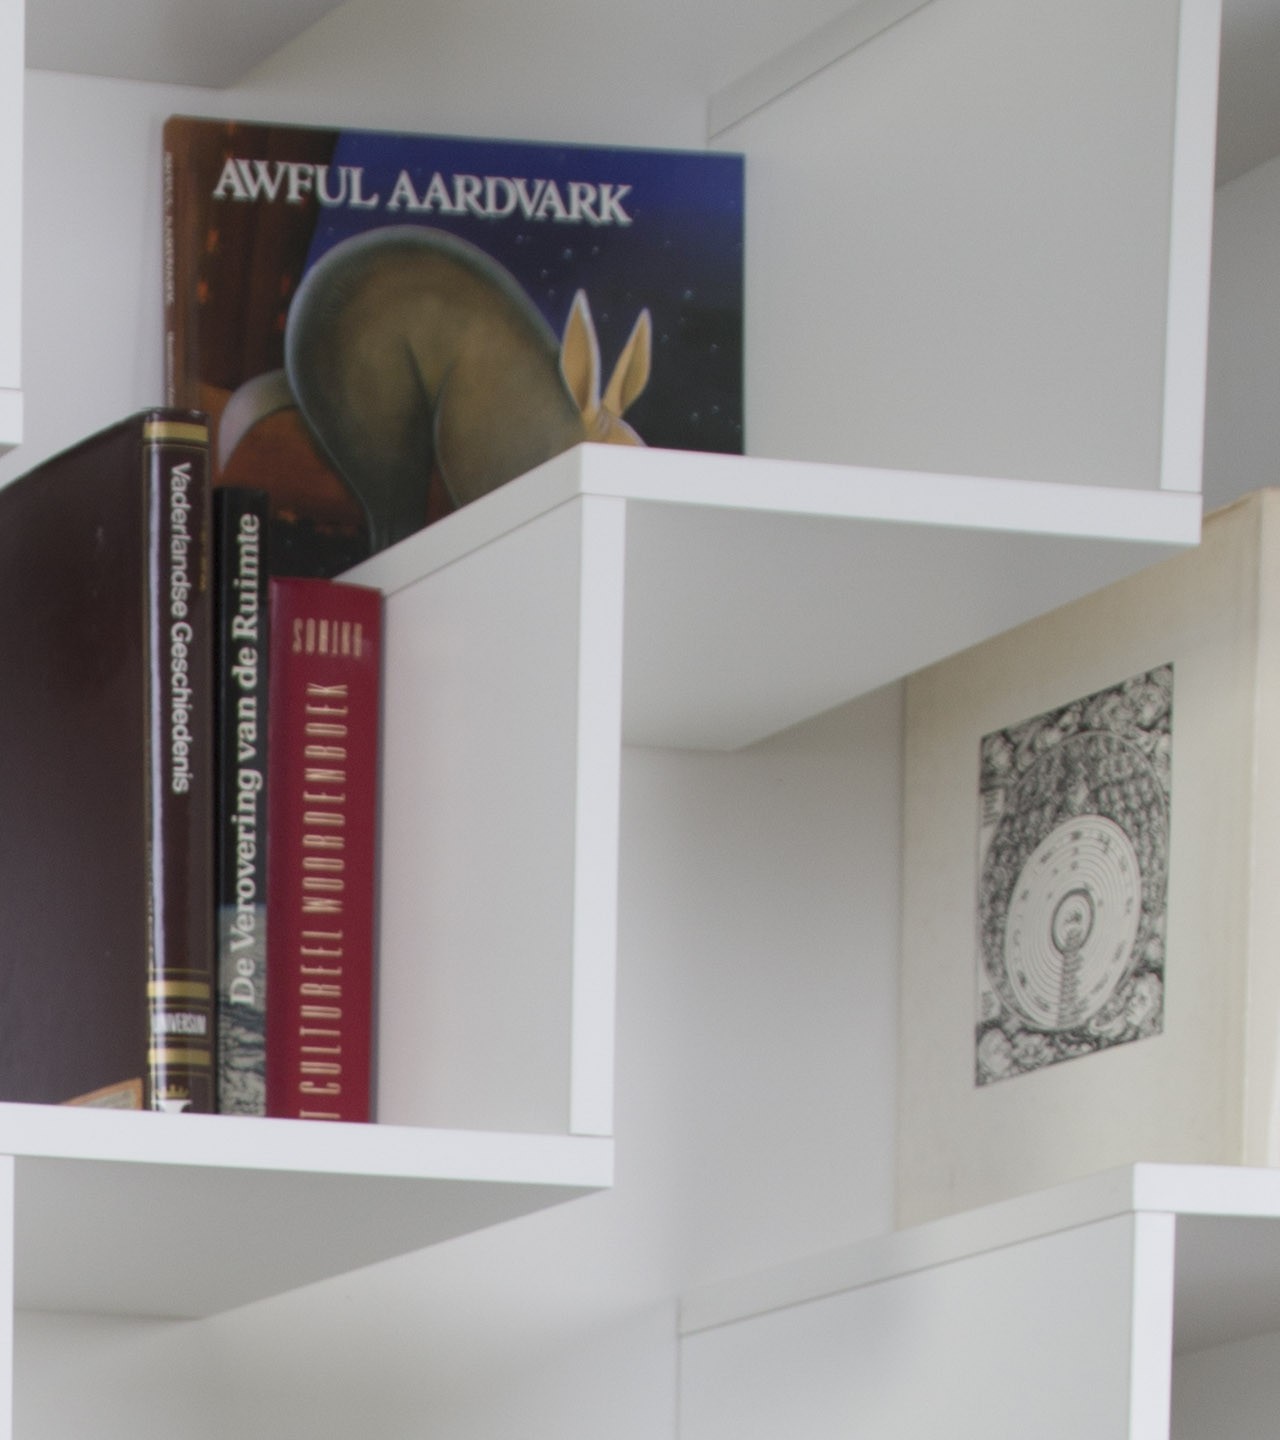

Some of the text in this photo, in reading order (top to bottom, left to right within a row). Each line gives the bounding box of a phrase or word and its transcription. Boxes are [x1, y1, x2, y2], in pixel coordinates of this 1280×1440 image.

[212, 157, 635, 227] AWFUL AARDVARK
[169, 462, 193, 794] Vaderlandse Geschiedenis
[229, 512, 263, 1006] De Verovering van de Ruimte
[301, 682, 348, 914] WOORDENBOEK
[299, 929, 344, 1095] CULTUREEL
